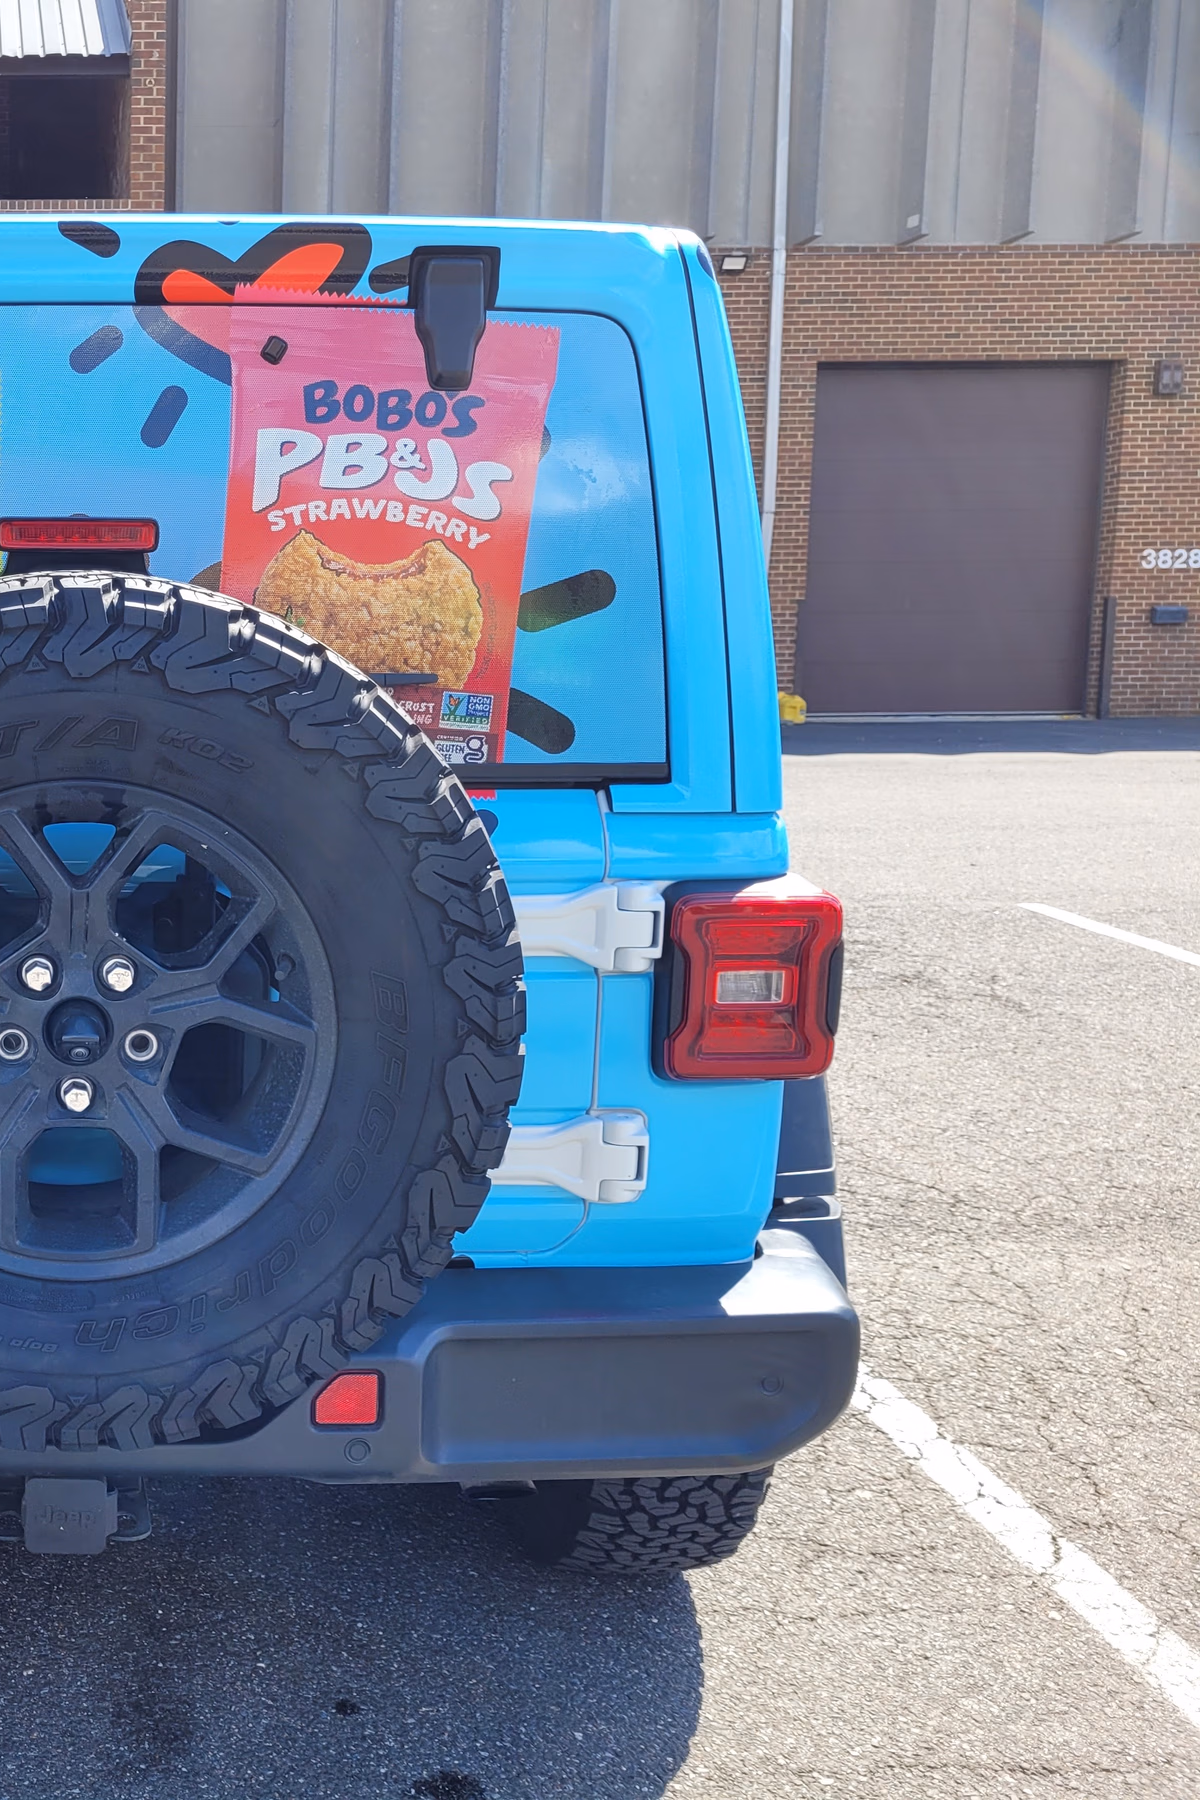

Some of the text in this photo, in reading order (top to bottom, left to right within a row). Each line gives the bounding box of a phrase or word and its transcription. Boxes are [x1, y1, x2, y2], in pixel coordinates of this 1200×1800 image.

[267, 498, 491, 549] STRAWBERRY
[1141, 548, 1200, 569] 3828
[468, 703, 490, 711] GMO
[469, 696, 490, 704] NON
[443, 715, 488, 725] VERIFIED
[437, 743, 465, 754] GLUTEN
[74, 969, 410, 1353] BFGoodrich
[9, 1336, 59, 1353] Baja
[36, 1504, 97, 1529] Jeep
